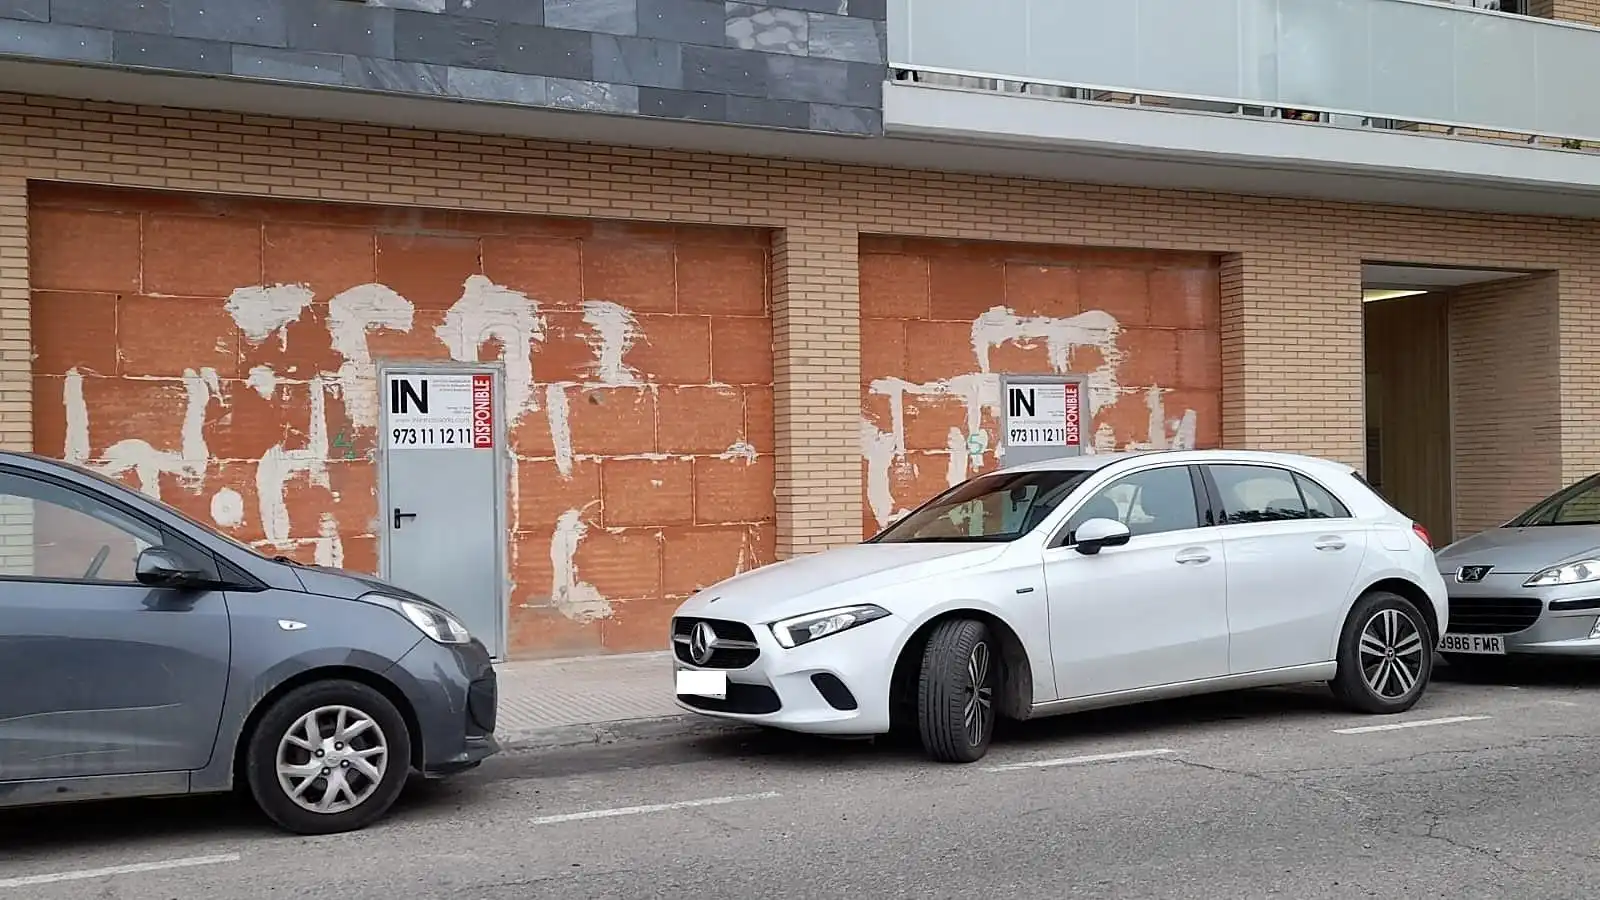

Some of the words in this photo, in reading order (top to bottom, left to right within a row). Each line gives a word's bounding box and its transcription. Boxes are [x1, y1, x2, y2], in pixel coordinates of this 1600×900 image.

[391, 379, 429, 414] IN
[1009, 388, 1035, 417] IN
[475, 379, 490, 444] DISPONIBLE
[1066, 388, 1078, 442] DISPONIBLE
[393, 428, 417, 445] 973
[421, 428, 434, 445] 11
[439, 428, 454, 445] 12
[457, 428, 471, 445] 11
[967, 434, 983, 455] 5
[1010, 428, 1027, 442] 973
[1029, 428, 1039, 442] 11
[1042, 428, 1053, 442] 12
[1055, 428, 1064, 442] 11
[1473, 637, 1500, 651] FMR
